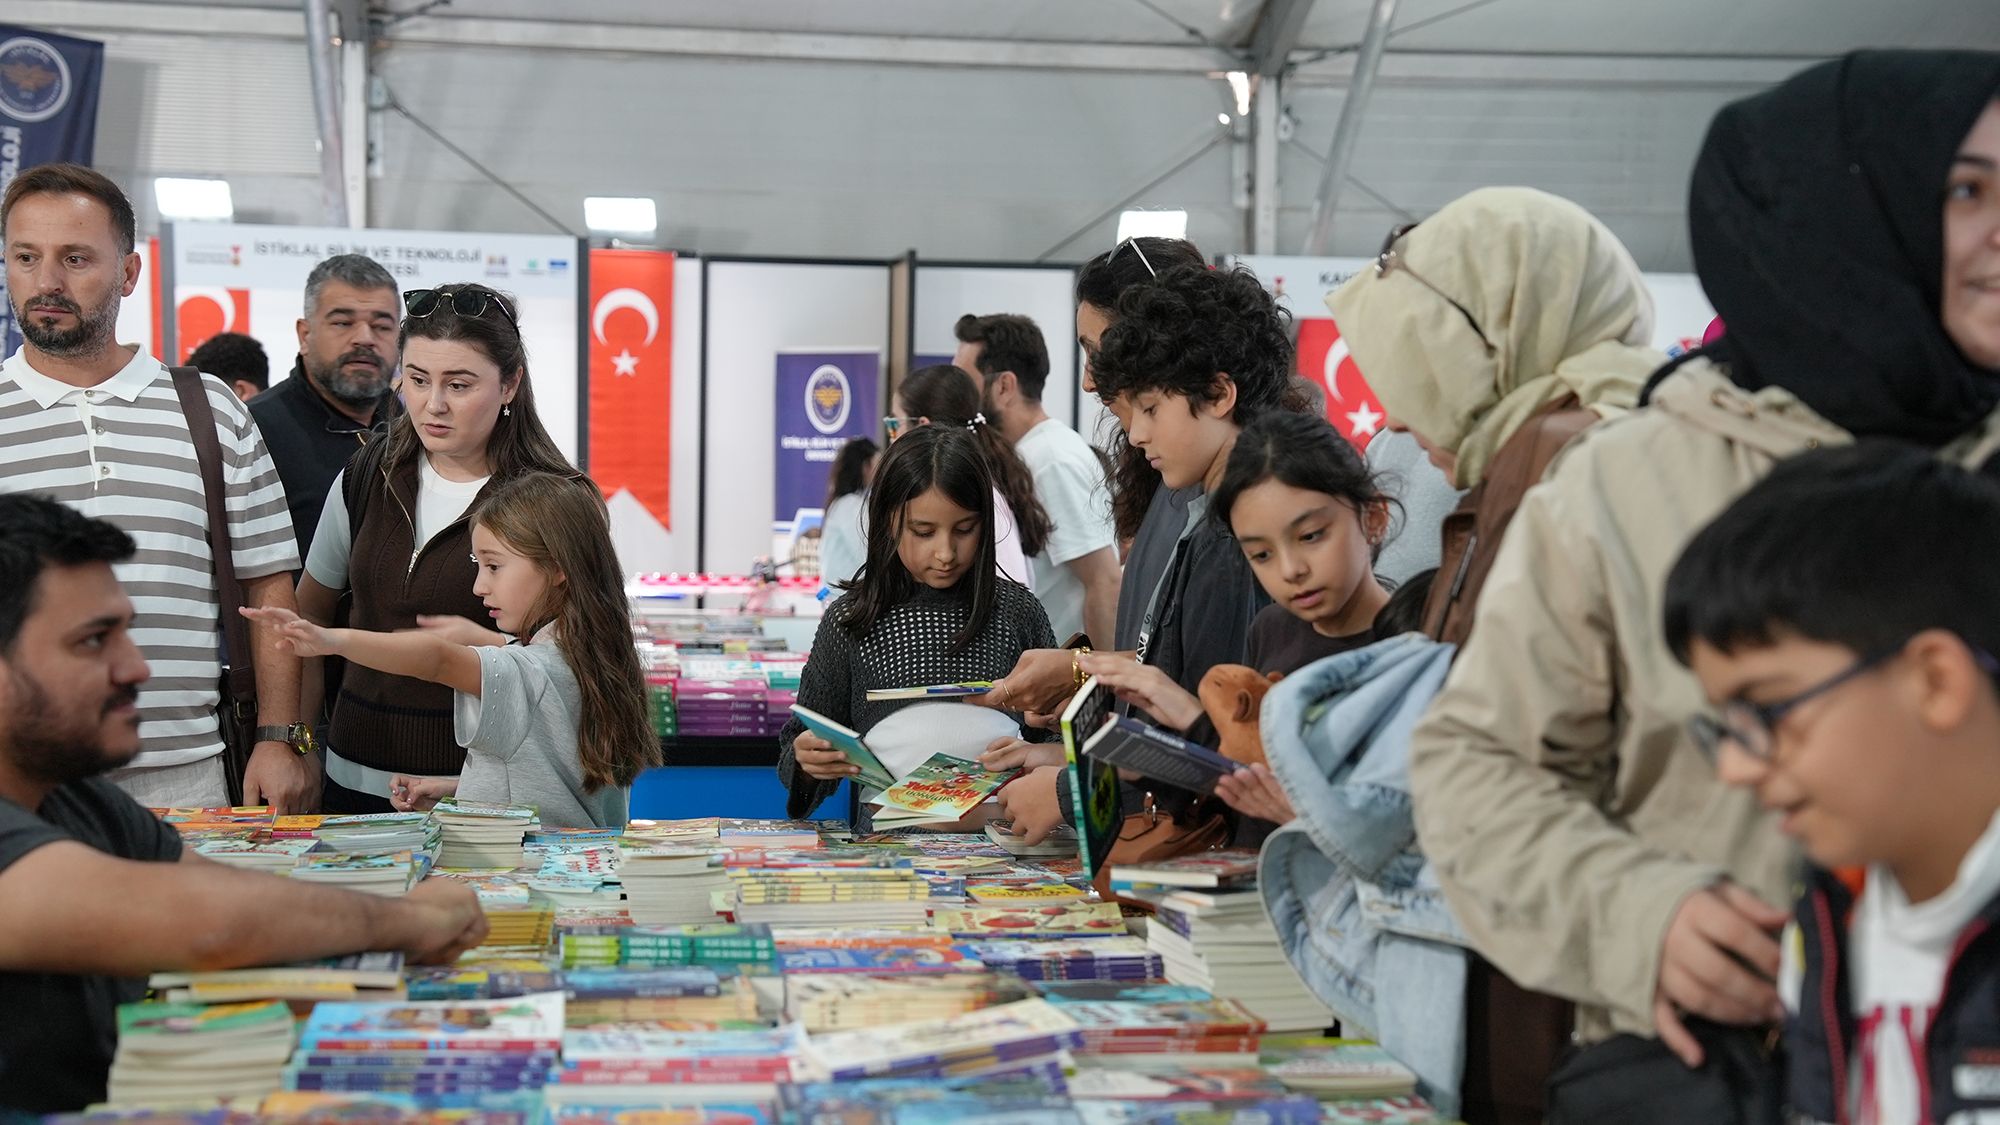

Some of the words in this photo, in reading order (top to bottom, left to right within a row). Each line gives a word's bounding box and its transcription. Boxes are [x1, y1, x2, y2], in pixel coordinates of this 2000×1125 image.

[254, 241, 320, 257] İSTİKLAL
[371, 246, 391, 258] VE
[396, 246, 481, 263] TEKNOLOJİ
